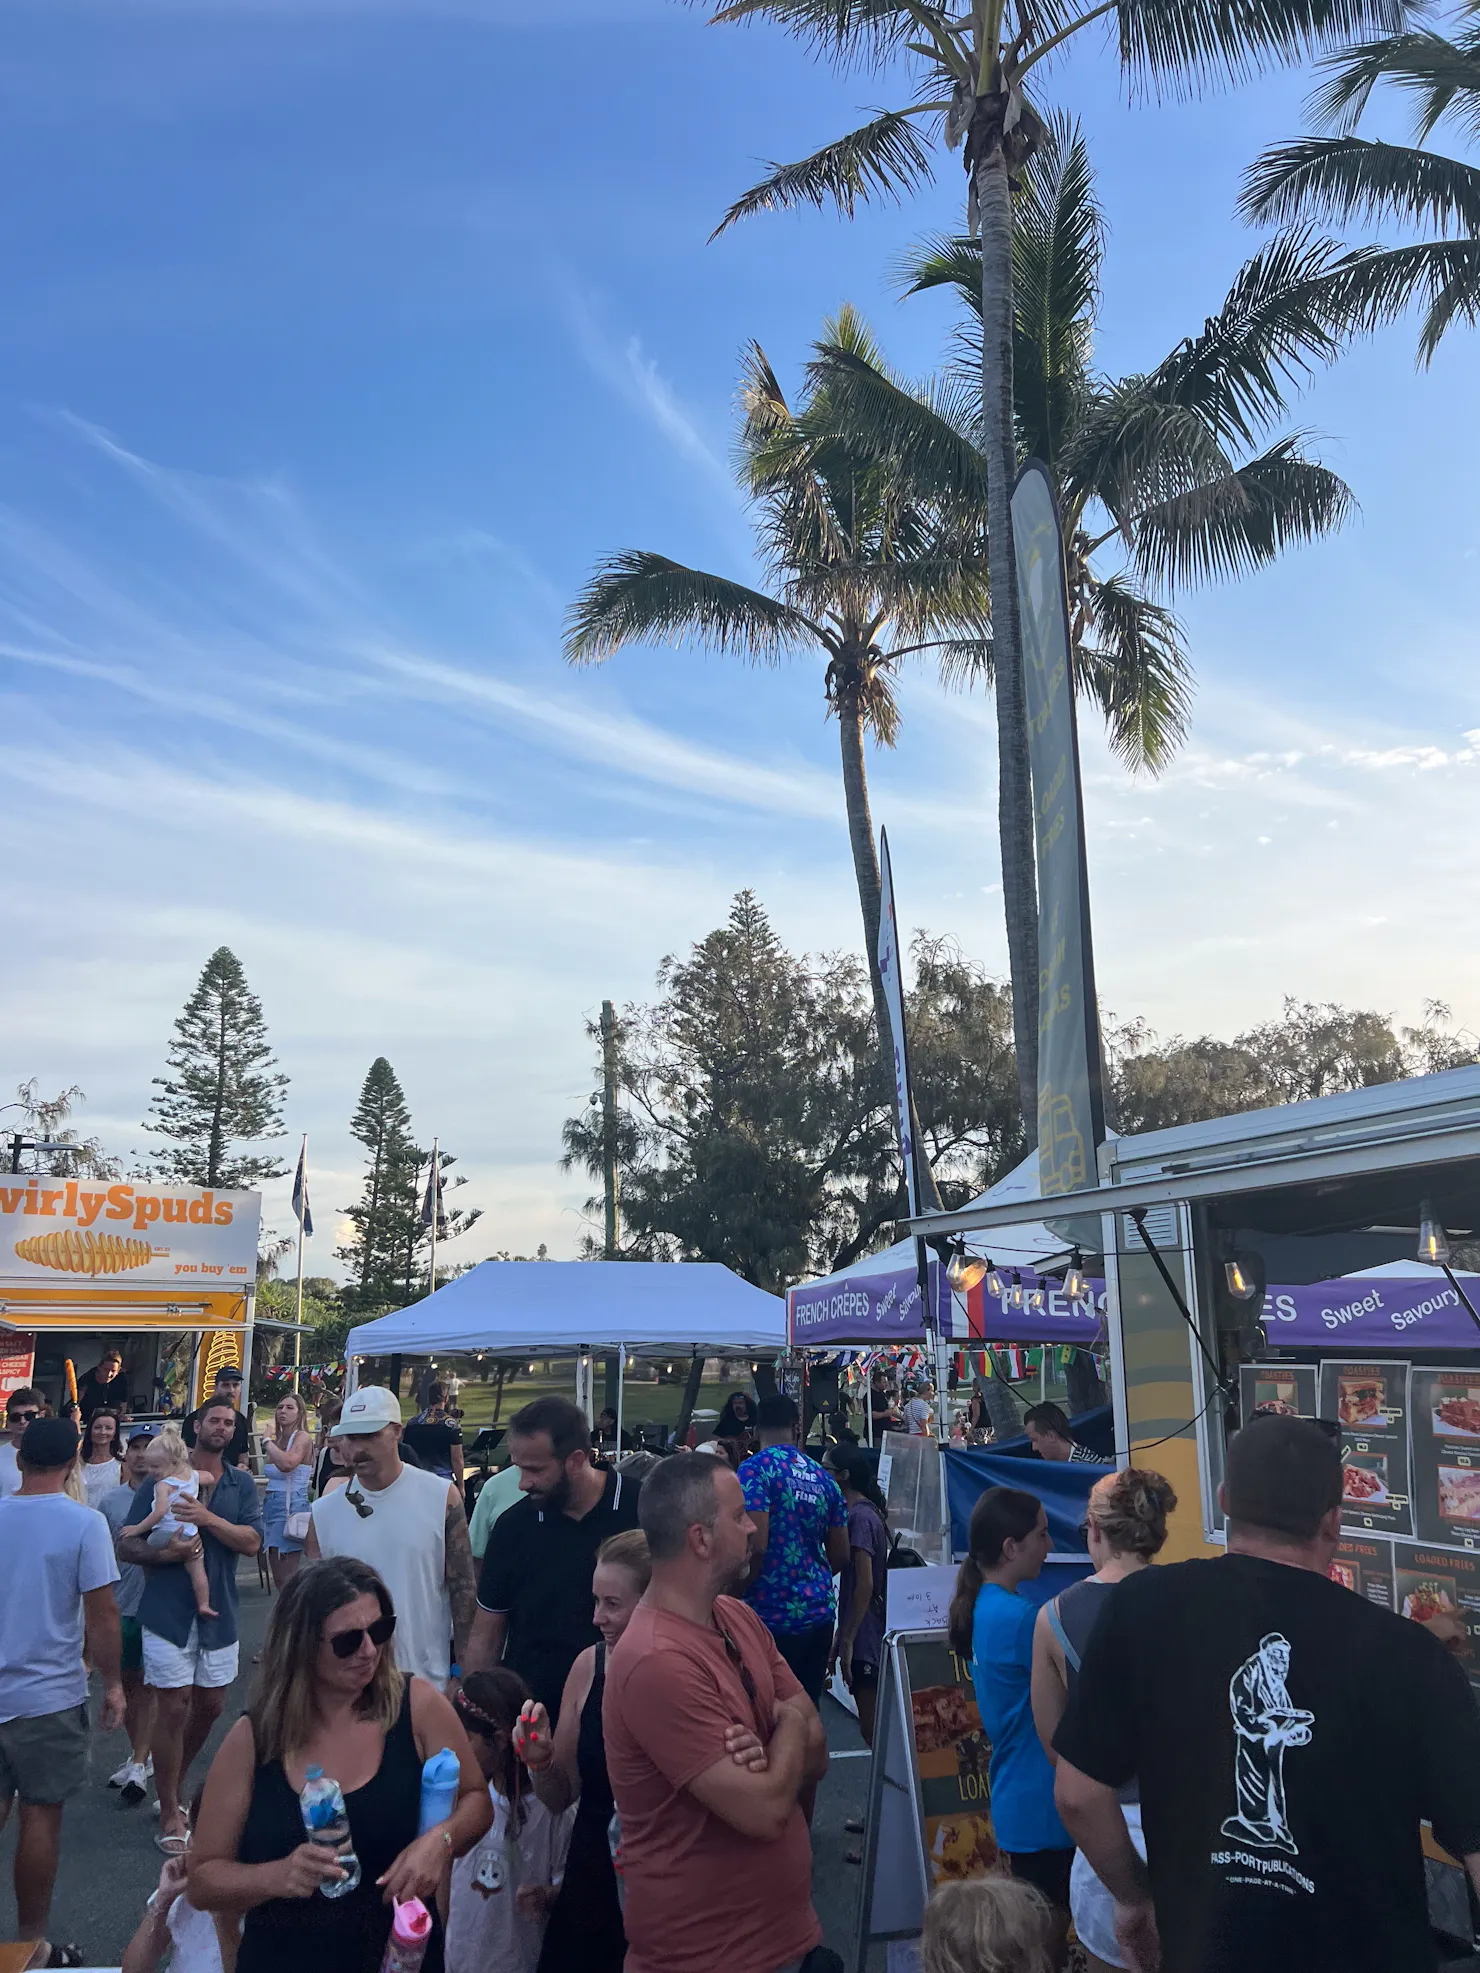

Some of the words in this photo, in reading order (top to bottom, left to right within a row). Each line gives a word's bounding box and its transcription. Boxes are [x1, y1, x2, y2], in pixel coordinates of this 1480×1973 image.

[174, 1264, 198, 1275] you
[201, 1262, 225, 1276] buy
[795, 1299, 829, 1327] FRENCH
[830, 1282, 870, 1318] CRÊPES
[875, 1282, 898, 1322] Sweet
[898, 1284, 922, 1322] Savou
[1320, 1289, 1385, 1330] Sweet
[1390, 1288, 1461, 1332] Savoury
[1414, 1553, 1448, 1567] LOADED
[1449, 1557, 1475, 1570] FRIES
